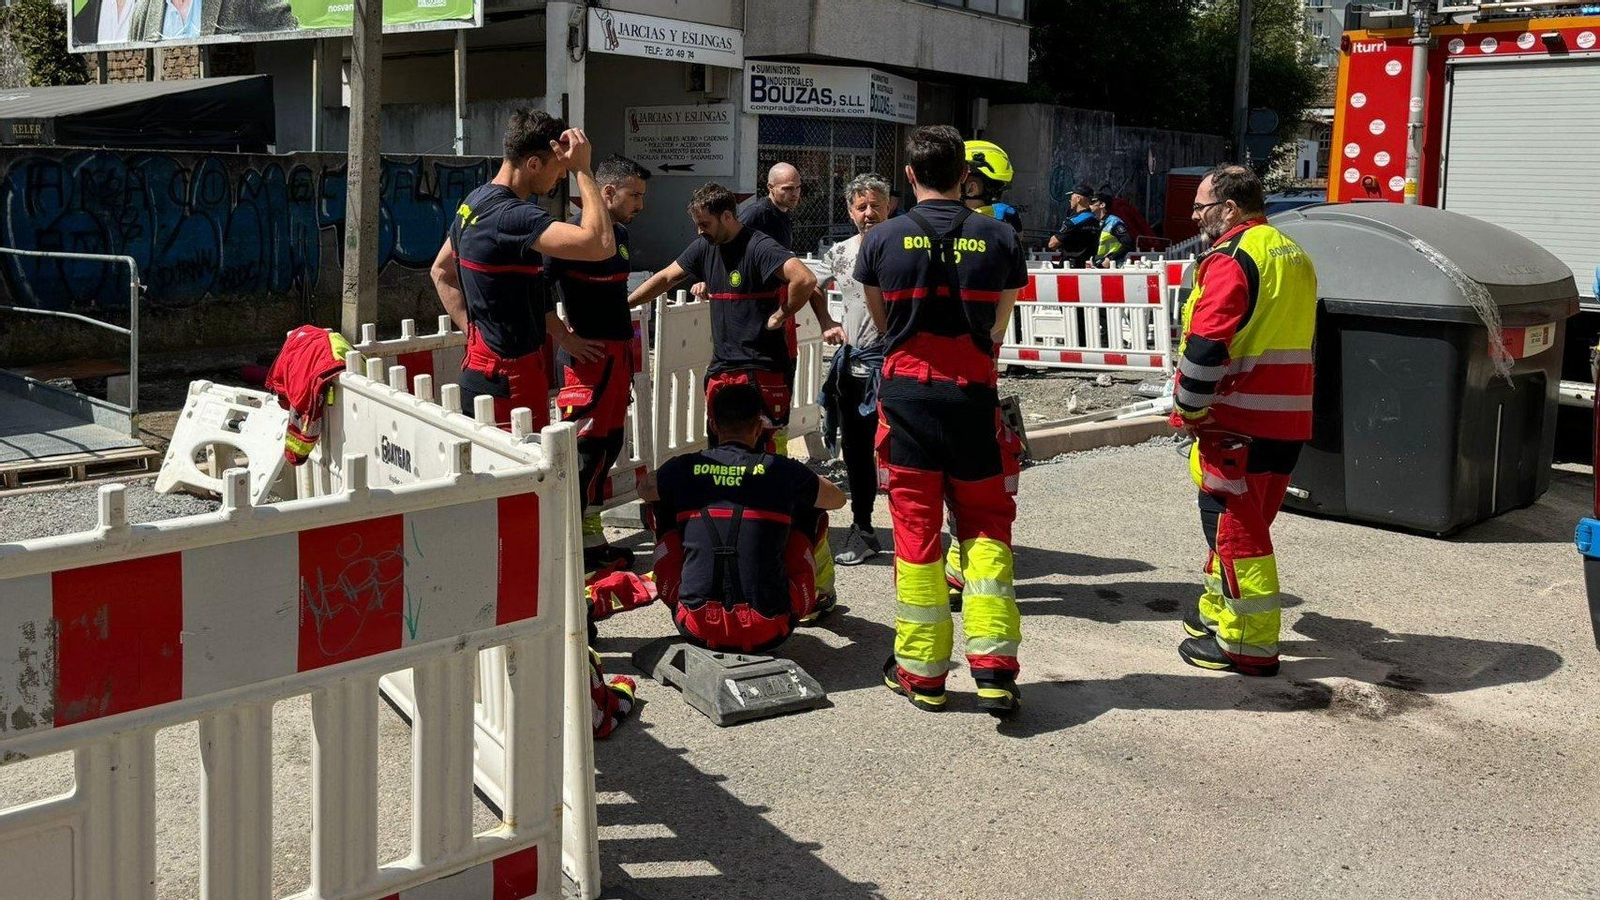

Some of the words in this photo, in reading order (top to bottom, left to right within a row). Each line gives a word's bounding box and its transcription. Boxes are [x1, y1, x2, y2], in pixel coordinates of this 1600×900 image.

[618, 22, 665, 40] JARCIAS
[669, 29, 678, 42] Y
[682, 31, 732, 49] ESLINGAS
[1353, 41, 1387, 53] iturri
[665, 49, 674, 57] 20
[676, 49, 685, 58] 49
[686, 50, 695, 59] 74
[756, 65, 800, 75] SUMINISTROS
[767, 77, 814, 87] INDUSTRIALES
[750, 75, 836, 107] BOUZAS,
[840, 95, 865, 107] S.L.L.
[750, 104, 865, 114] compras@sumibouzas.com
[639, 112, 672, 123] JARCIAS
[675, 111, 682, 122] Y
[685, 110, 727, 122] ESLINGAS
[12, 124, 41, 134] KELER
[903, 236, 986, 253] BOMIROS
[693, 464, 765, 476] BOMBEIRS
